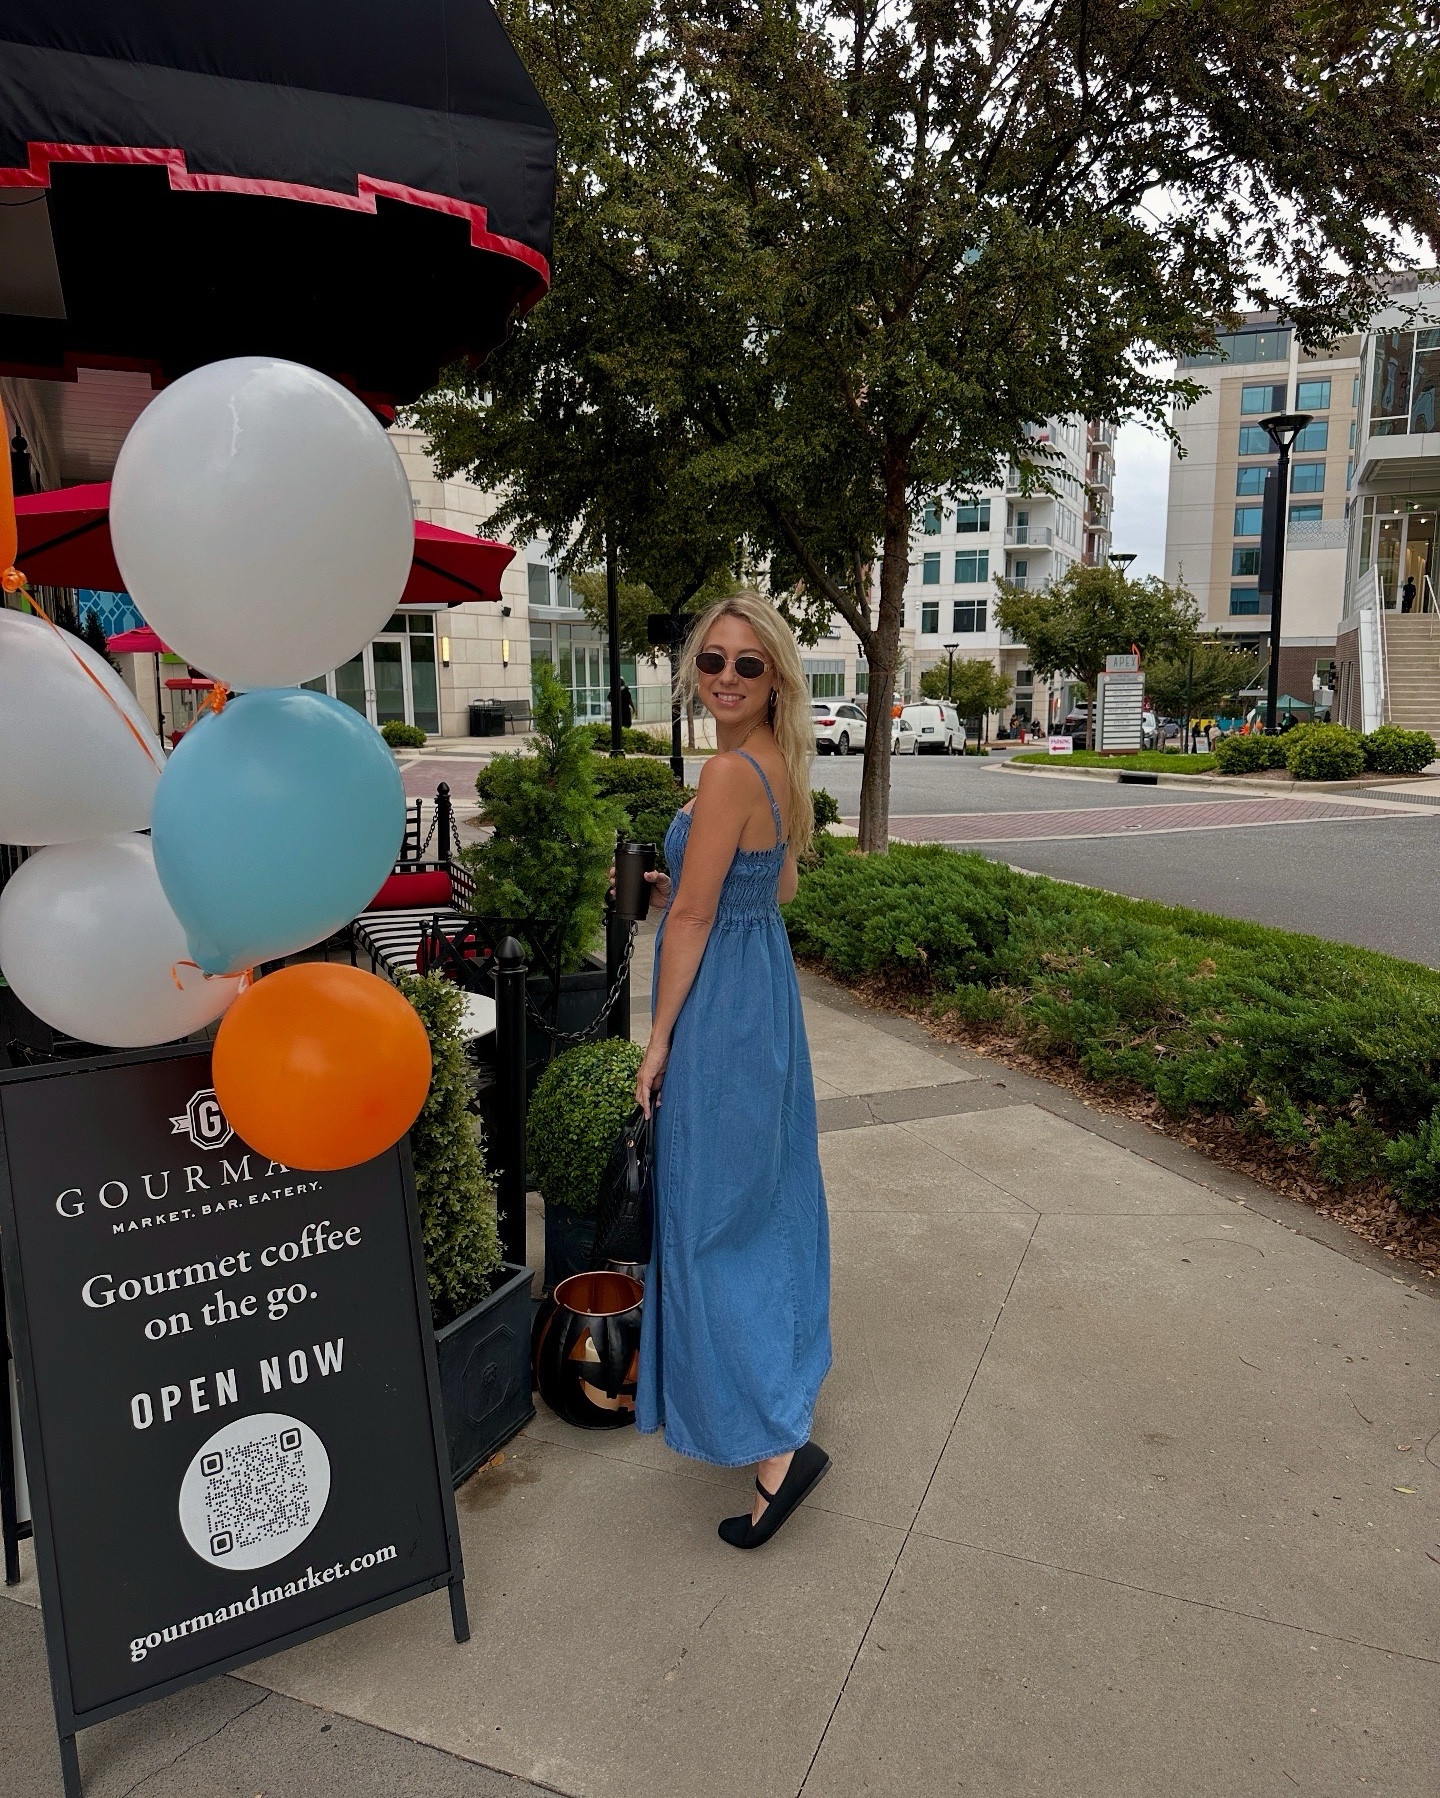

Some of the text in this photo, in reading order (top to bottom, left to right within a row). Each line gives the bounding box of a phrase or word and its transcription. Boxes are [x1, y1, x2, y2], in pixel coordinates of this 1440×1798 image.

[1113, 656, 1137, 668] APEX
[198, 1100, 222, 1138] G
[56, 1154, 291, 1218] GOURMA
[113, 1180, 324, 1235] MARKET. BAR. EATERY.
[81, 1220, 362, 1309] Gourmet coffee
[144, 1283, 319, 1341] on the go.
[130, 1337, 344, 1430] OPEN NOW
[129, 1543, 398, 1663] gourmandmarket.com
